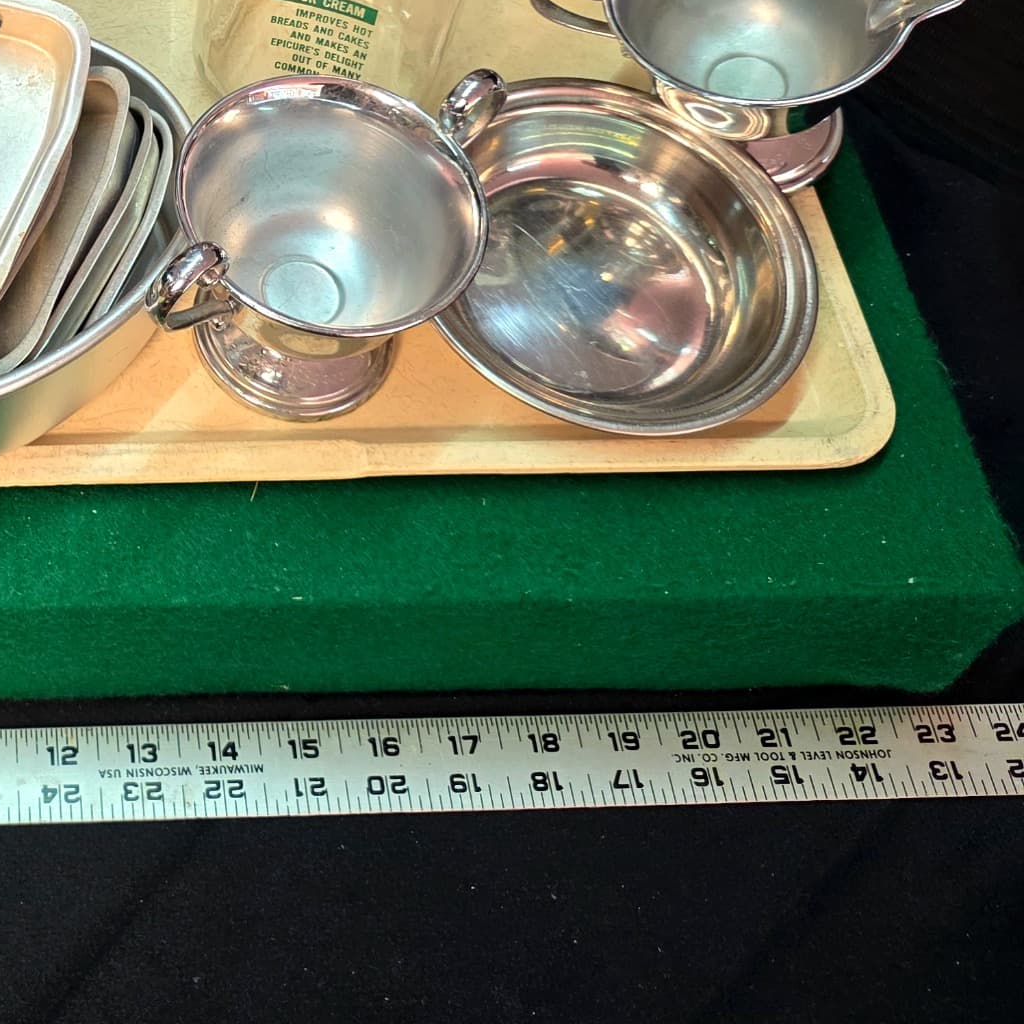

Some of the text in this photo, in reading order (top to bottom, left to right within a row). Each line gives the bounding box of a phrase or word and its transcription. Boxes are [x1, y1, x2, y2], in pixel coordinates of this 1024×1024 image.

[271, 15, 370, 50] BREADS AND CAKES
[296, 8, 375, 39] IMPROVES HOT
[271, 37, 365, 71] EPICURE'S DELIGHT
[290, 31, 368, 61] AND MAKES AN
[292, 53, 363, 81] OUT OF MANY
[46, 746, 78, 766] 12
[126, 743, 158, 763] 13
[207, 741, 239, 761] 14
[288, 739, 320, 759] 15
[368, 737, 400, 757] 16
[448, 735, 478, 755] 17
[528, 733, 560, 753] 18
[608, 731, 640, 751] 19
[680, 729, 721, 750] 20
[757, 727, 793, 747] 21
[835, 726, 878, 745] 22
[914, 724, 956, 743] 23
[802, 750, 832, 761] LEVEL
[836, 749, 892, 760] JOHNSON
[698, 753, 718, 763] CO.
[721, 752, 750, 762] MFG.
[755, 752, 785, 761] TOOL
[788, 752, 796, 761] &
[99, 763, 264, 779] MILWAUKEE, WISCONSIN USA
[530, 771, 563, 791] 18
[613, 768, 644, 789] 17
[691, 766, 724, 787] 16
[770, 764, 804, 785] 15
[850, 762, 884, 782] 14
[929, 760, 963, 781] 13
[41, 783, 80, 804] 24
[123, 781, 163, 802] 23
[204, 779, 244, 800] 22
[294, 777, 326, 797] 21
[367, 775, 408, 795] 20
[449, 773, 482, 793] 19
